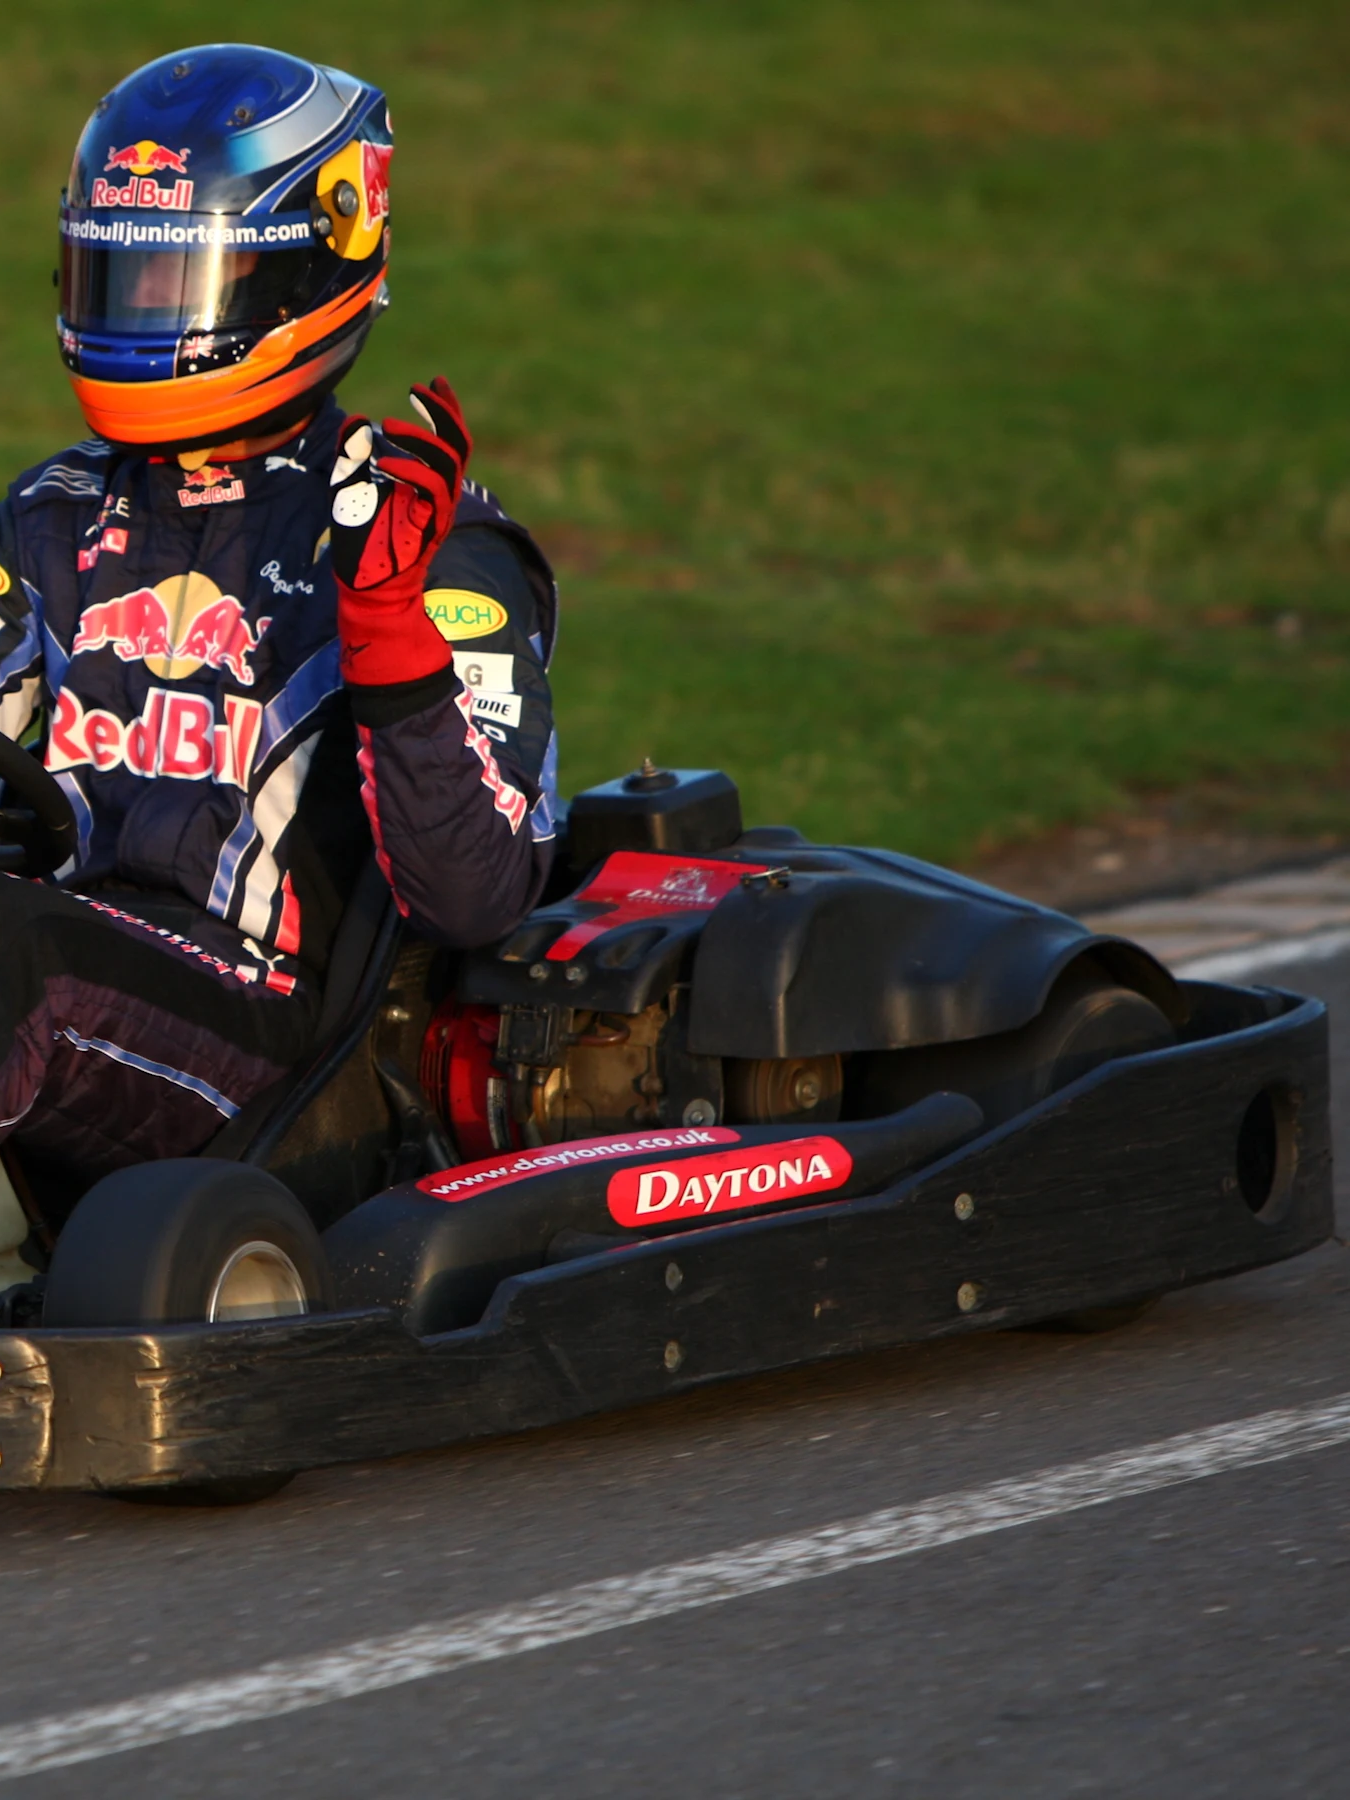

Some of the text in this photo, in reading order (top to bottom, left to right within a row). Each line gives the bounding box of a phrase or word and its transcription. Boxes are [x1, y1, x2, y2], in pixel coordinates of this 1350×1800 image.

[91, 176, 194, 211] Red Bull
[177, 479, 245, 508] Red Bull
[44, 686, 166, 778] Red
[429, 1129, 716, 1195] www.daytona.co.uk
[635, 1153, 833, 1215] DAYTONA
